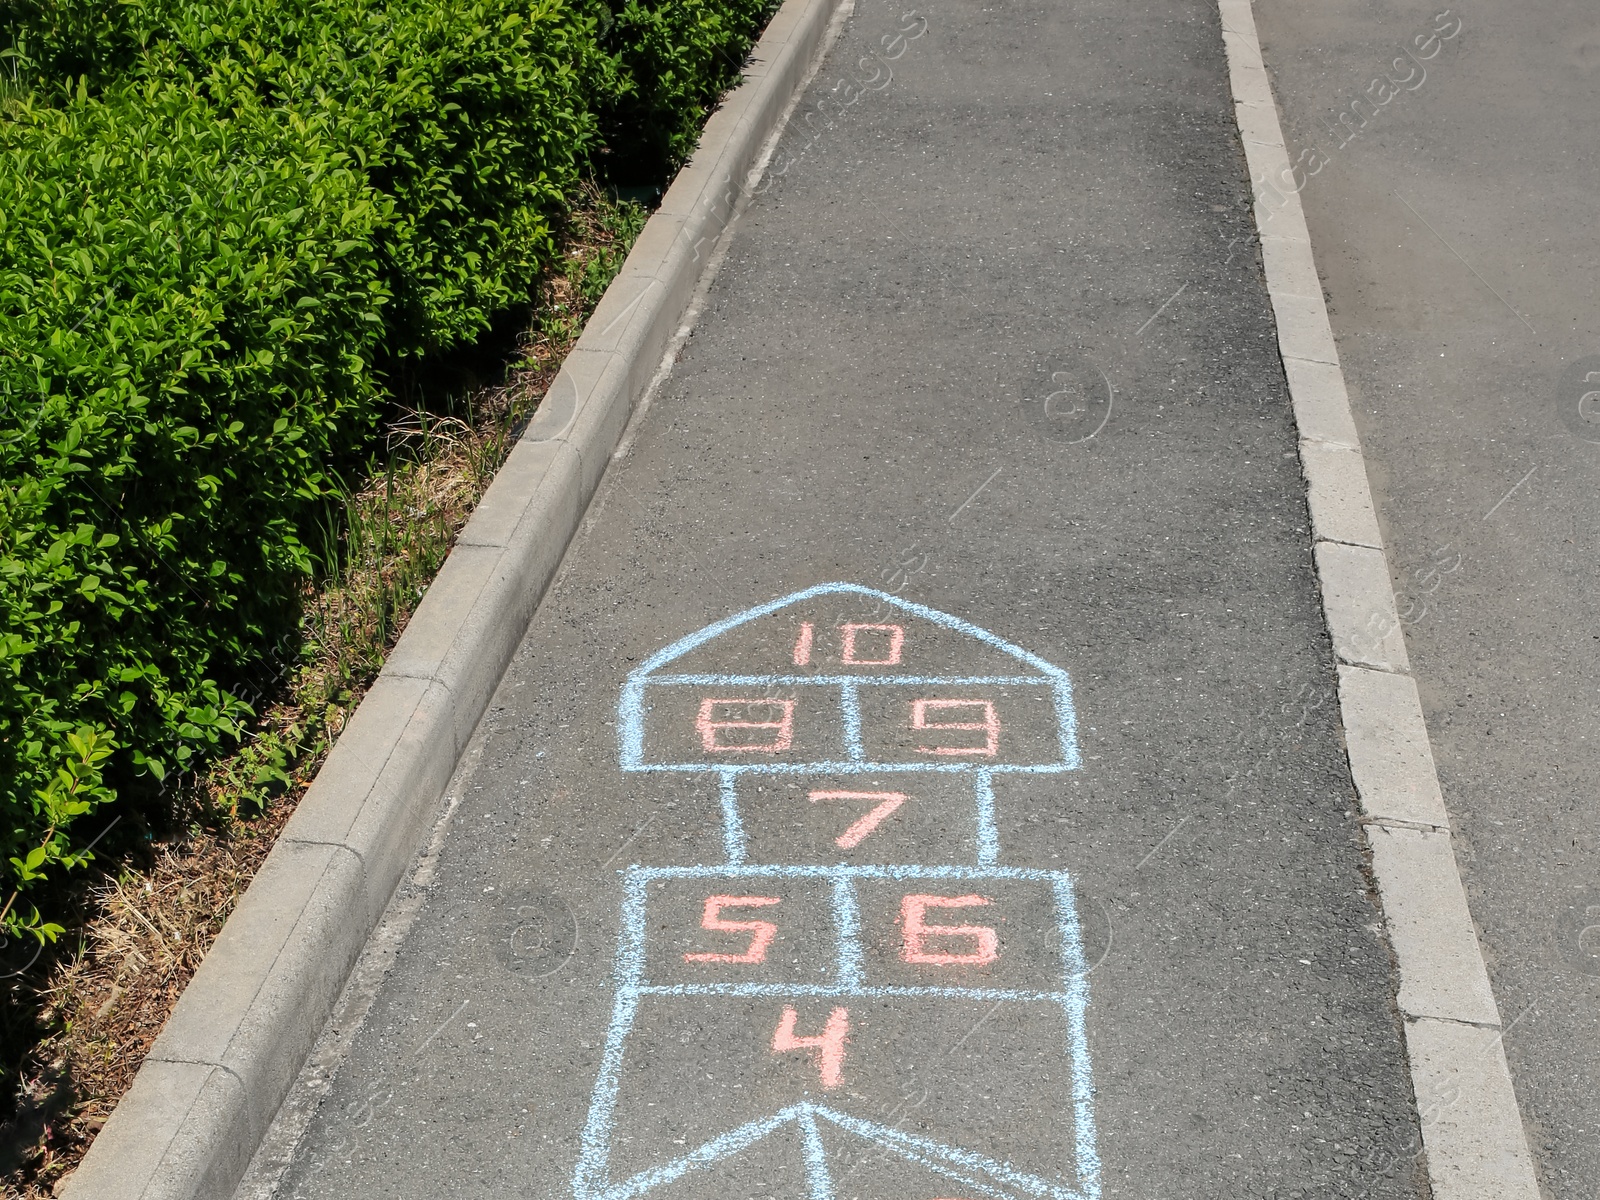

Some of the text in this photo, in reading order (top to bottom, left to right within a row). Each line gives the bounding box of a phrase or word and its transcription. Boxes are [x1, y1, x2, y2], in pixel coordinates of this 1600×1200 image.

[793, 622, 905, 665] 10
[696, 698, 795, 753] 8
[911, 699, 1000, 756] 9
[809, 789, 908, 849] 7
[683, 894, 781, 964] 5
[898, 893, 999, 967] 6
[772, 1006, 850, 1088] 4
